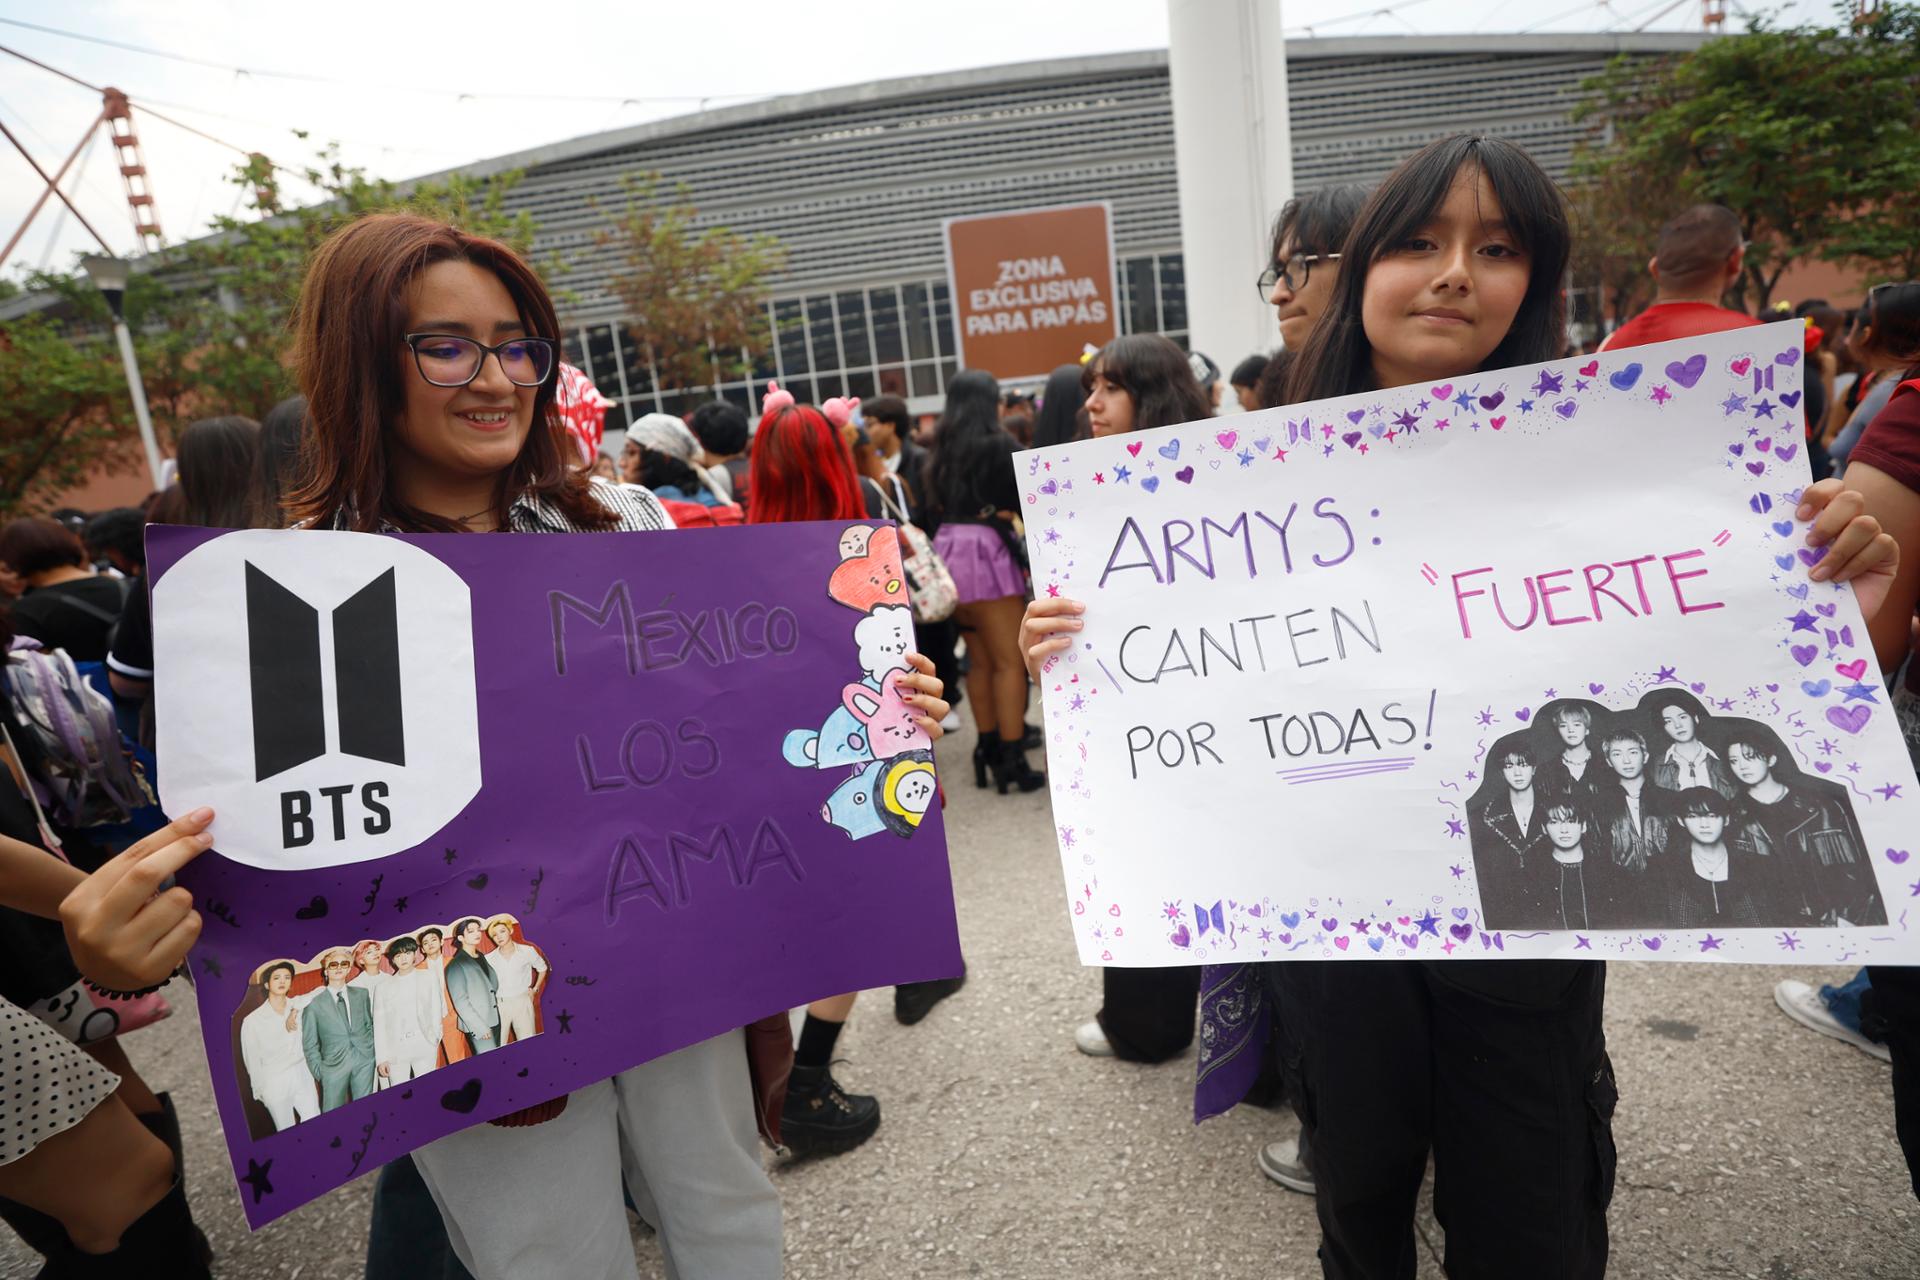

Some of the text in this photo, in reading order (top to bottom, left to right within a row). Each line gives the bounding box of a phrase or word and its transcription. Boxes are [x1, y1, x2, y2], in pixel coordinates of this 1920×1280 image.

[969, 277, 1098, 311] EXCLUSIVA
[997, 255, 1066, 284] ZONA
[966, 311, 1028, 337] PARA
[1098, 497, 1381, 588] ARMYS:
[1043, 655, 1059, 673] BTS
[575, 717, 721, 793] LOS
[1126, 689, 1436, 779] POR TODAS!
[280, 781, 391, 849] BTS
[604, 816, 807, 927] AMA
